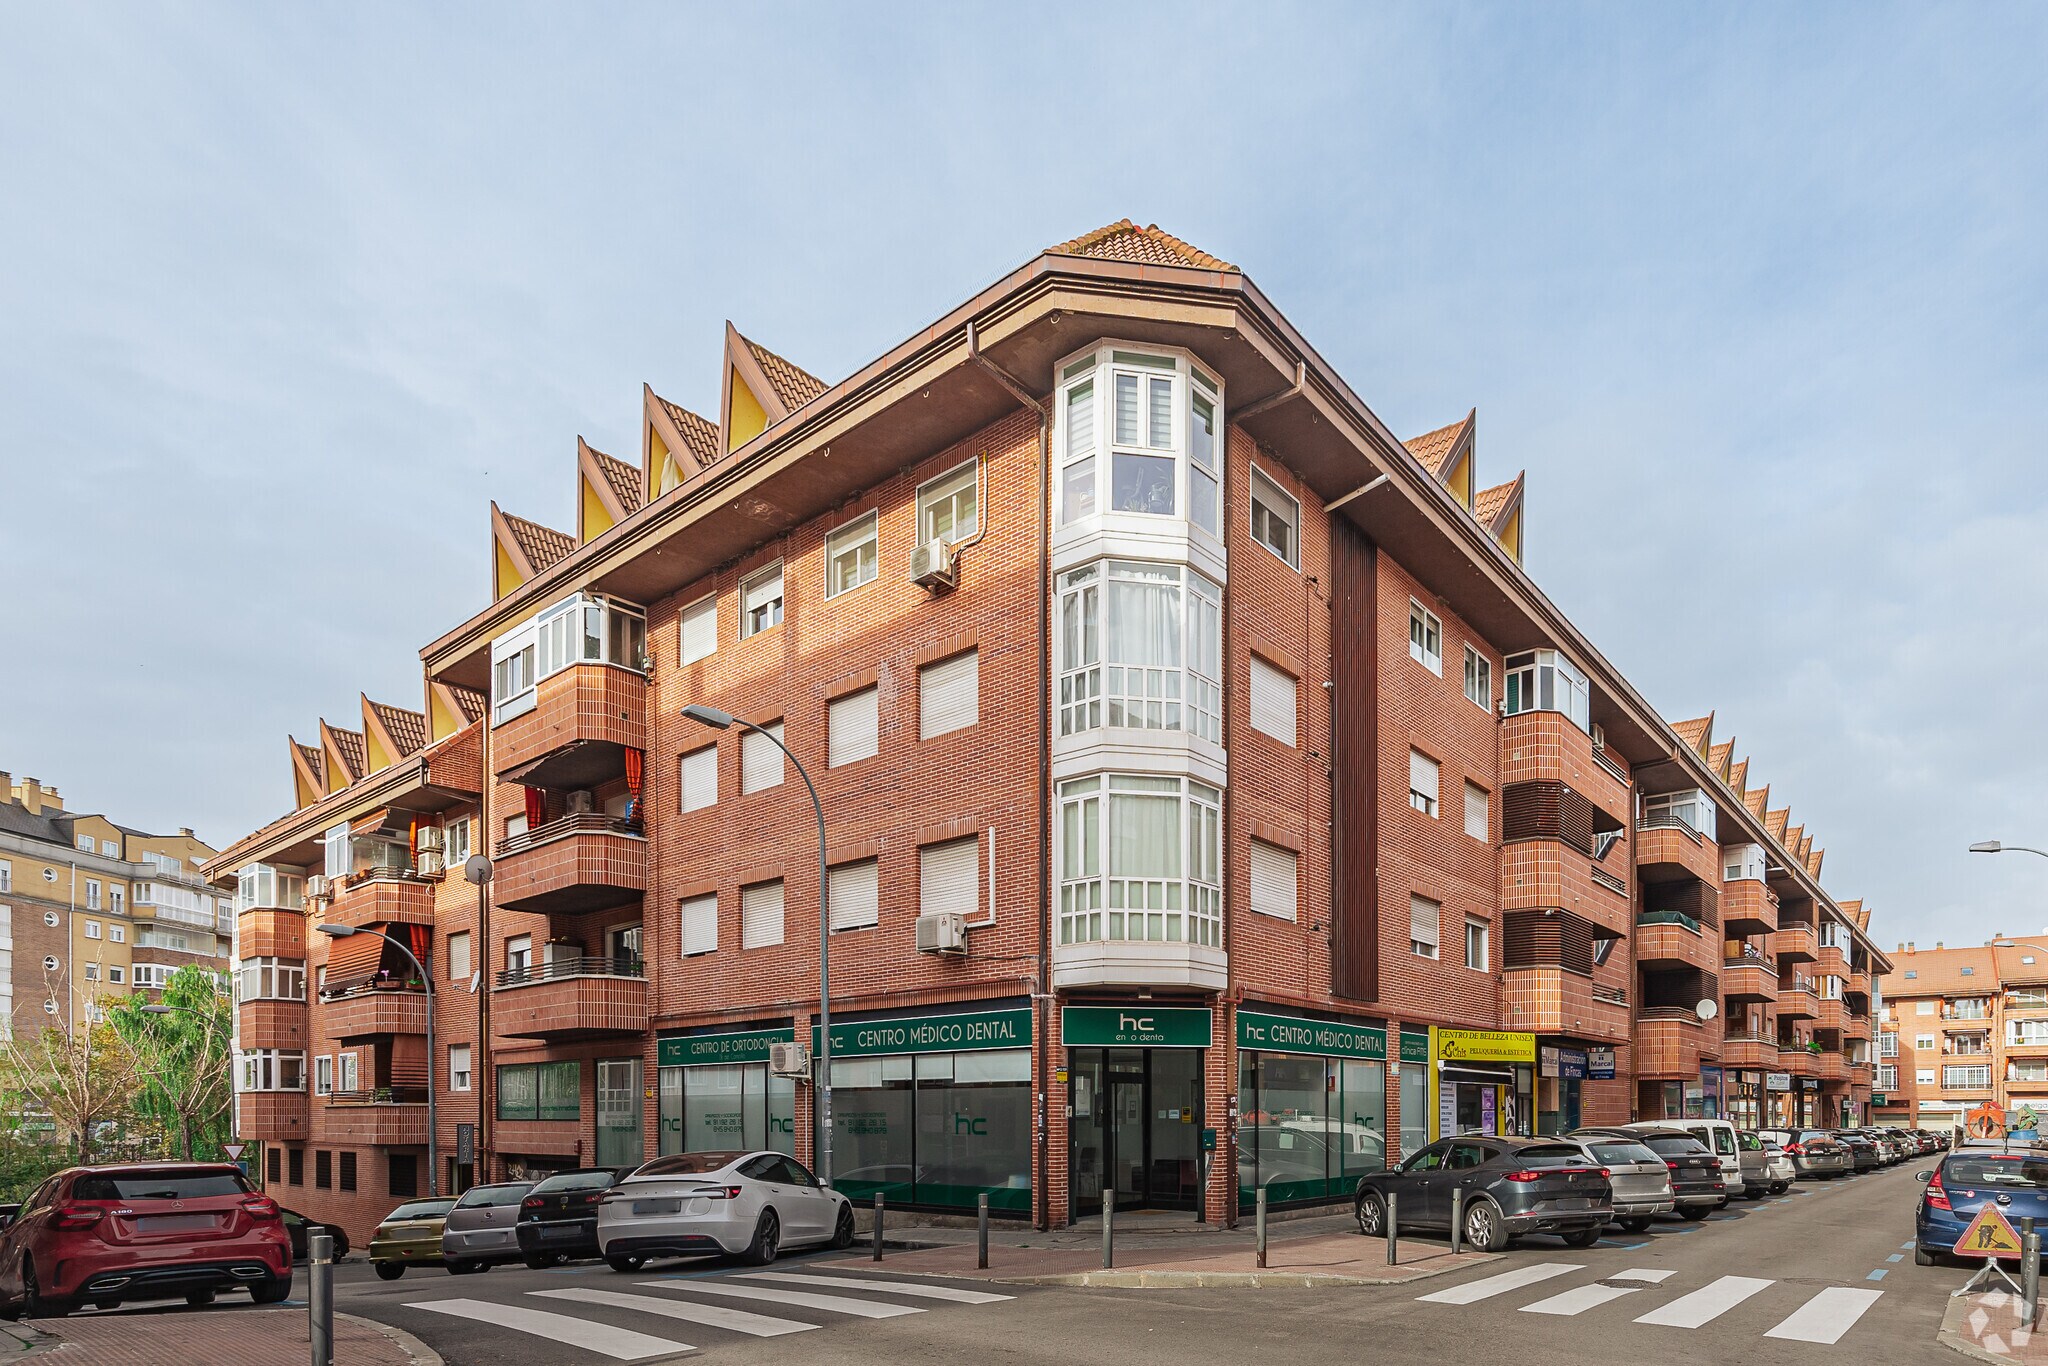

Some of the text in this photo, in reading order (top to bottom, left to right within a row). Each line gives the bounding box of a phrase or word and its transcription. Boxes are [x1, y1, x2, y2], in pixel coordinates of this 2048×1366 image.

[1120, 1013, 1155, 1031] hc
[857, 1028, 906, 1047] CENTRO
[910, 1023, 962, 1045] MÉDICO
[966, 1020, 1017, 1041] DENTAL
[1246, 1022, 1384, 1052] hc CENTRO MÉDICO DENTAL
[1440, 1031, 1469, 1039] CENTRO
[1480, 1032, 1509, 1041] BELLEZA
[1510, 1033, 1534, 1042] UNISEX
[667, 1043, 681, 1056] hc
[691, 1042, 719, 1055] CENTRO
[721, 1041, 730, 1053] DE
[1469, 1047, 1503, 1056] PELUQUERÍA
[1507, 1048, 1532, 1056] ESTÉTICA
[662, 1113, 680, 1131] hc
[770, 1113, 793, 1132] hc
[955, 1112, 987, 1135] hc
